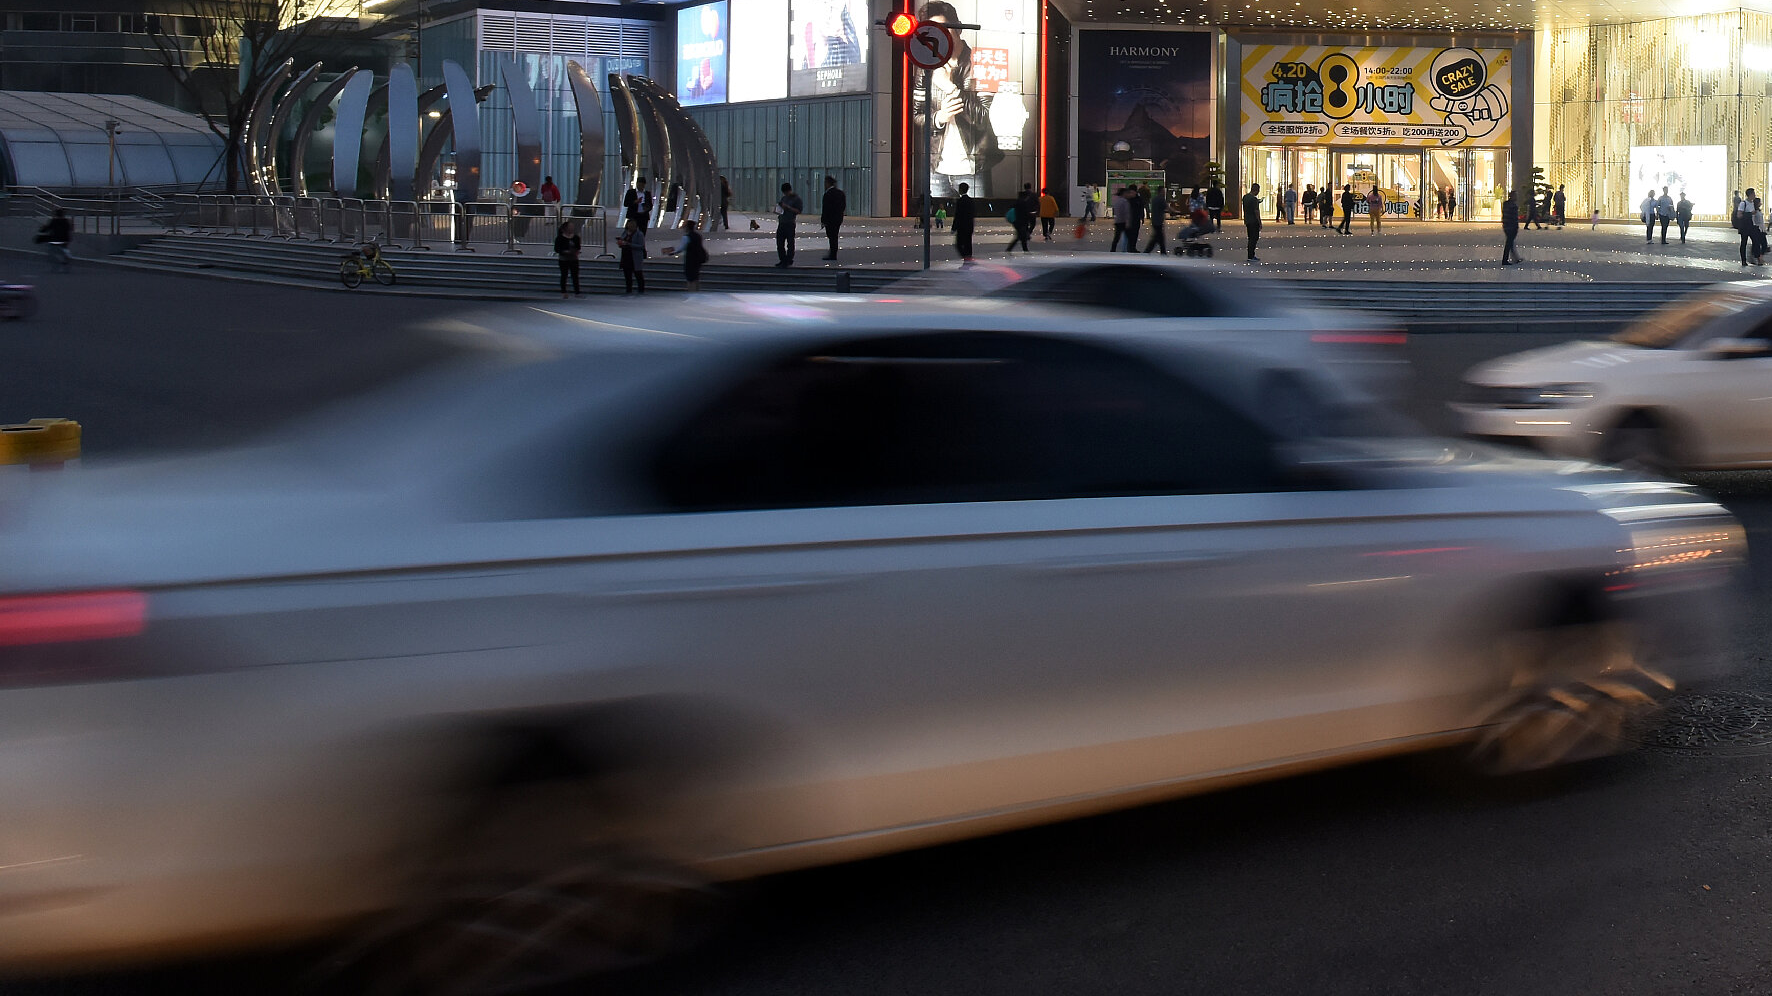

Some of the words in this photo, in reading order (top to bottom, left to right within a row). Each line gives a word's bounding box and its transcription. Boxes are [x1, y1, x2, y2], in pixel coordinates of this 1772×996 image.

[1109, 46, 1180, 57] HARMONY
[1273, 63, 1307, 78] 4.20
[1441, 63, 1475, 86] CRAZY
[1450, 76, 1477, 94] SALE
